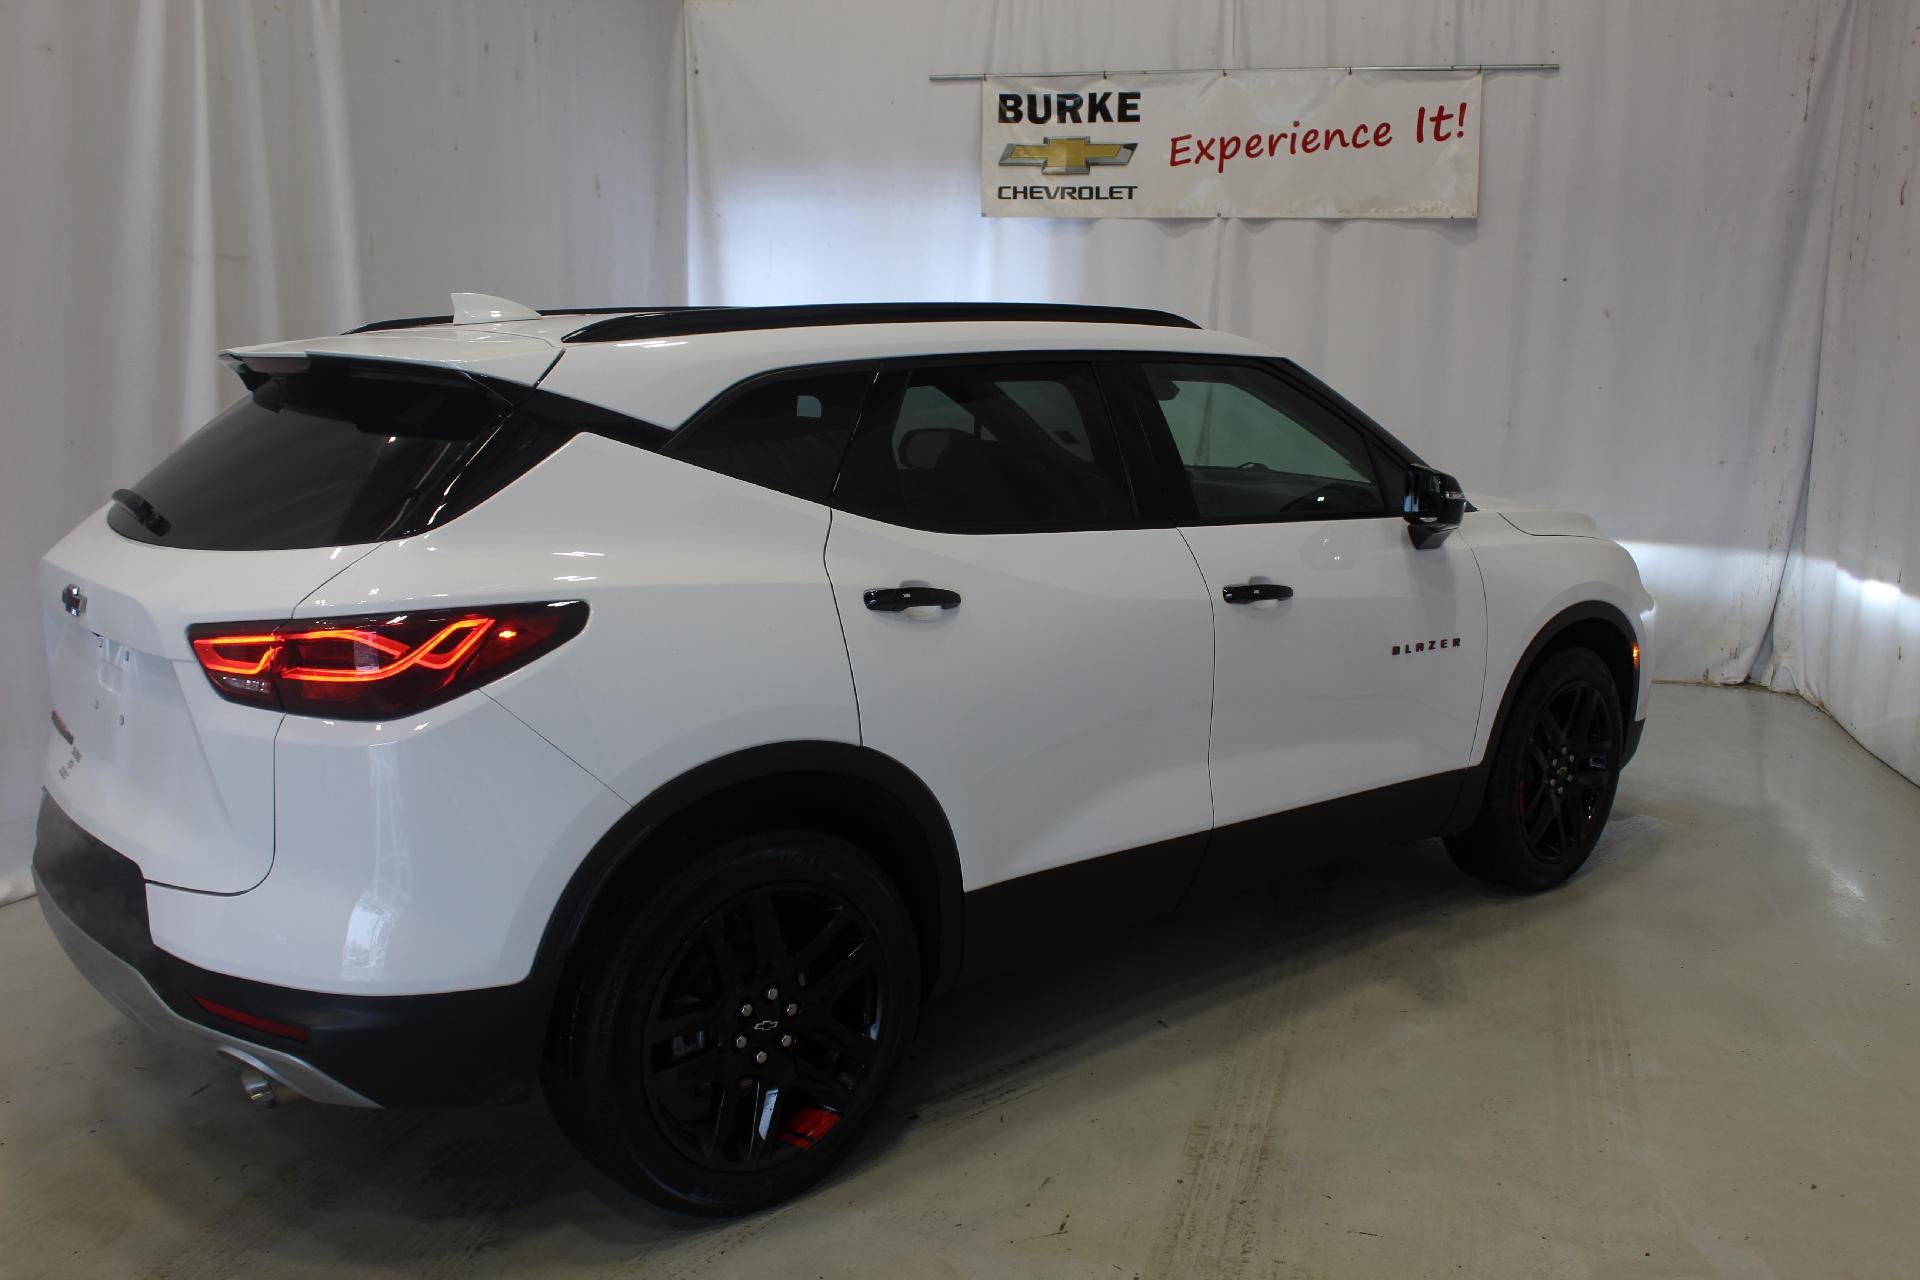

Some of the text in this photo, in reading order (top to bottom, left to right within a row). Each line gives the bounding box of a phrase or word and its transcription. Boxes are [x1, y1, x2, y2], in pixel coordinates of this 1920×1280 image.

[998, 91, 1141, 125] BURKE
[1169, 102, 1467, 173] Experience It!
[997, 185, 1139, 201] CHEVROLET
[1391, 637, 1461, 656] BLAZER
